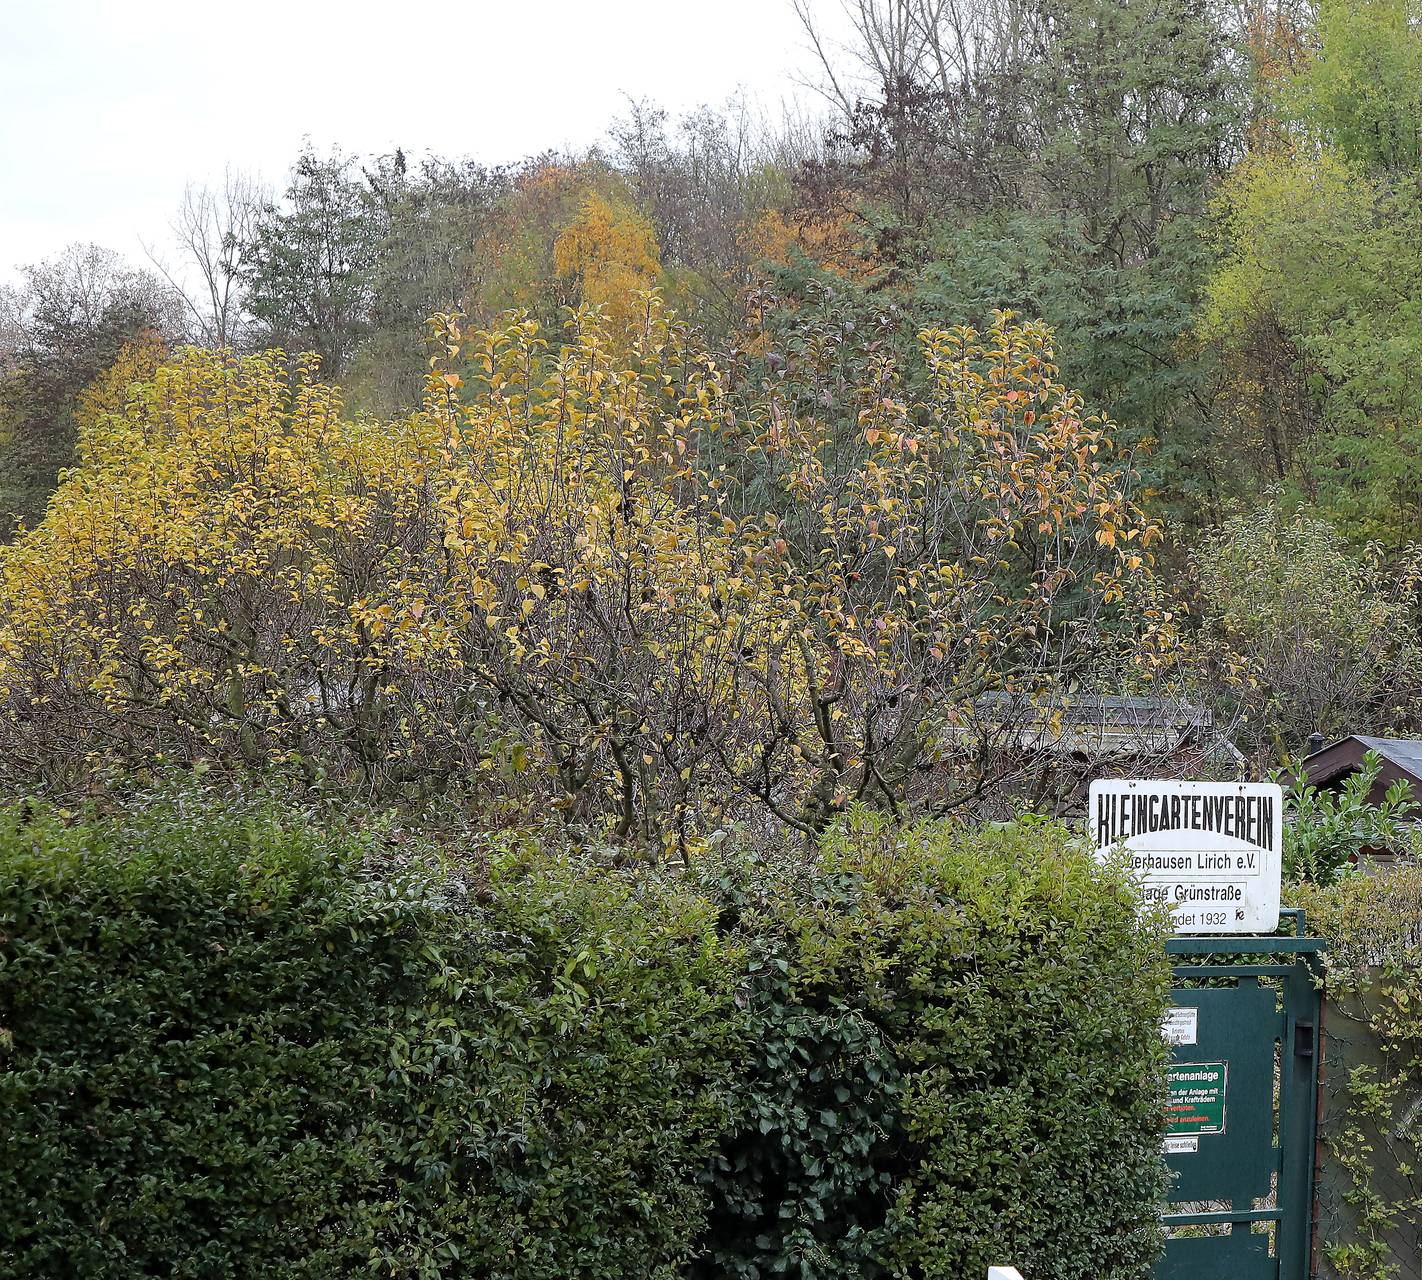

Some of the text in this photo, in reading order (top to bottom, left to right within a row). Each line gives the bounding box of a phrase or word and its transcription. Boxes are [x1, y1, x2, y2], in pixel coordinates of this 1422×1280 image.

[1097, 793, 1273, 852] KLEINGARTENVEREIN
[1197, 852, 1231, 870] Lirich
[1237, 852, 1256, 870] e.V.
[1174, 884, 1242, 902] Grünstraße
[1200, 912, 1227, 926] 1932
